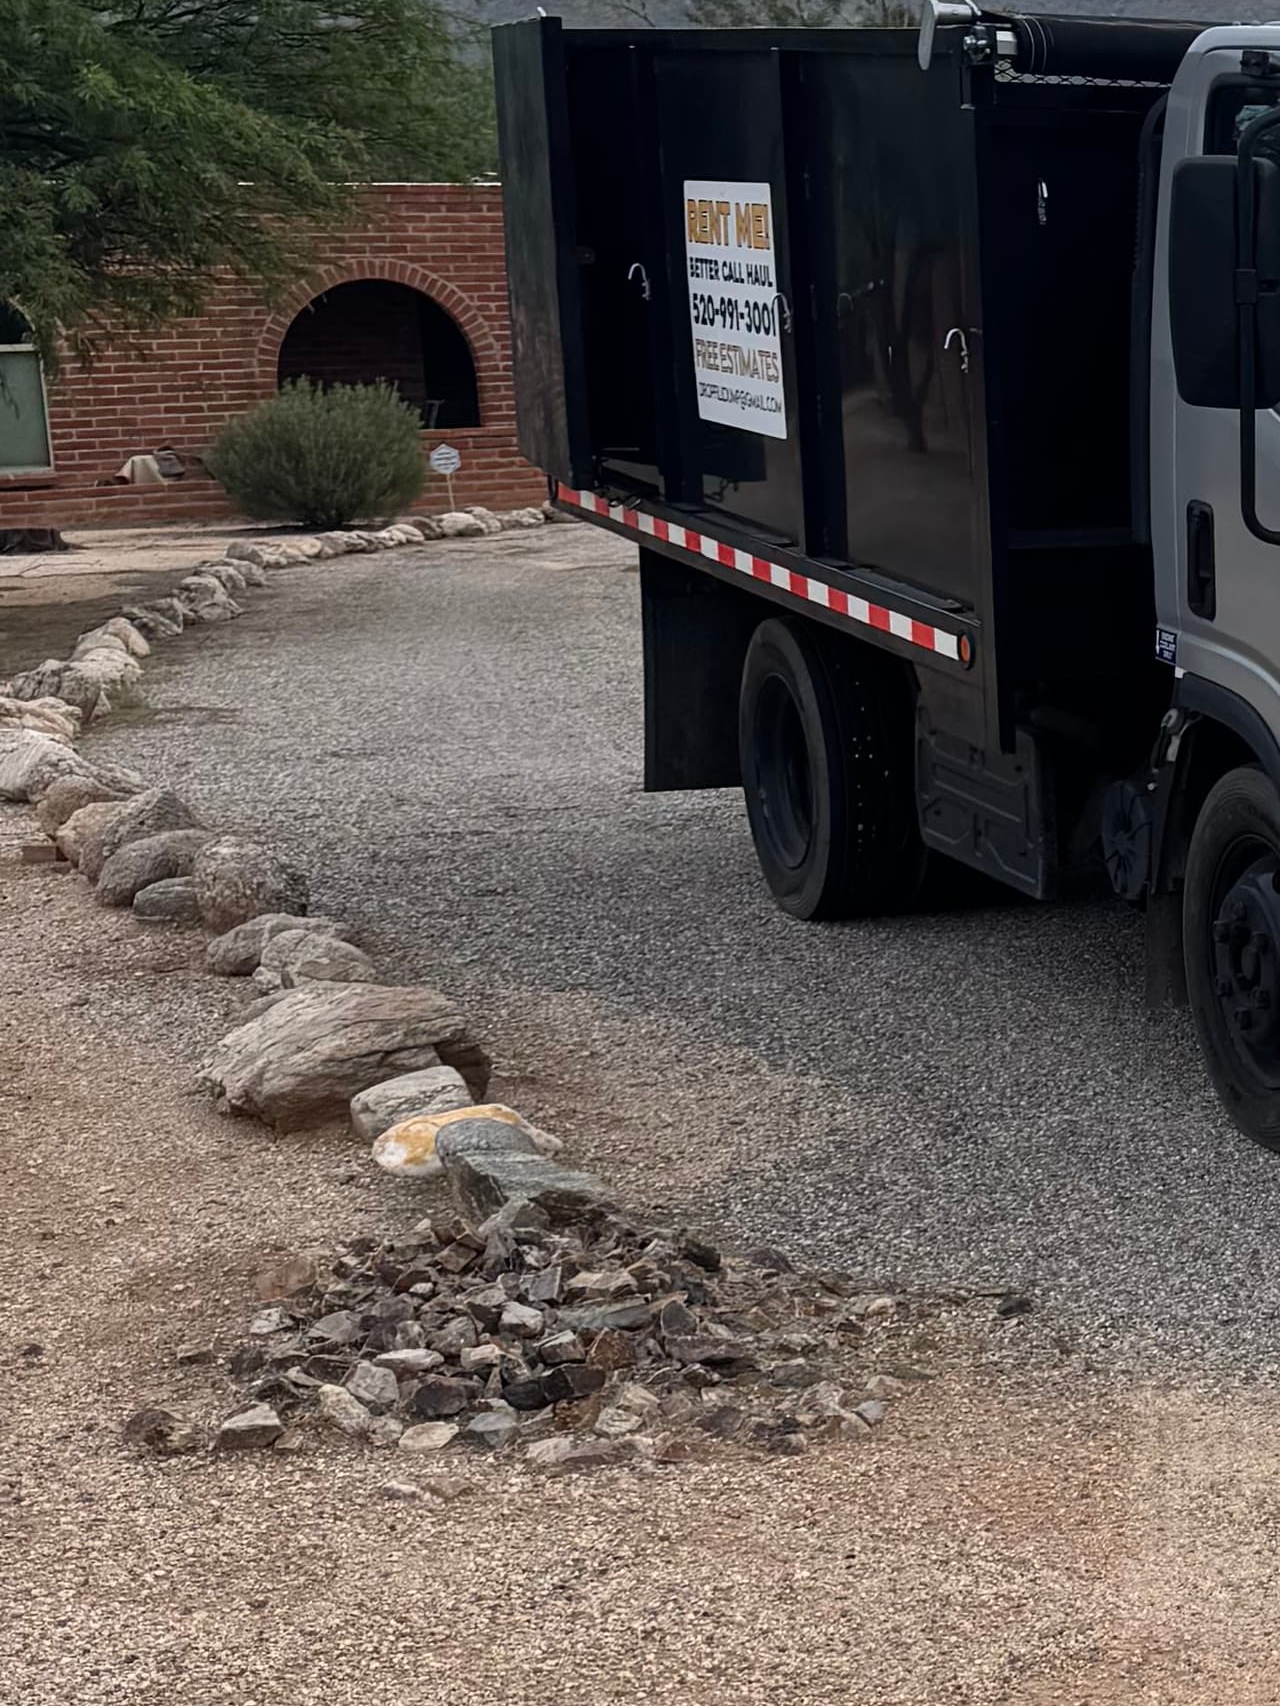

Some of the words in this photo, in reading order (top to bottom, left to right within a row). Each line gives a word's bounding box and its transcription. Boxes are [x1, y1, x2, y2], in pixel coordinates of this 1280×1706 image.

[687, 198, 731, 246] RENT
[689, 256, 720, 281] BETTER
[721, 260, 745, 284] CALL
[745, 263, 773, 288] HAUL
[692, 292, 777, 337] 520-991-3001
[695, 338, 720, 371] FREE
[719, 342, 780, 383] ESTIMATES
